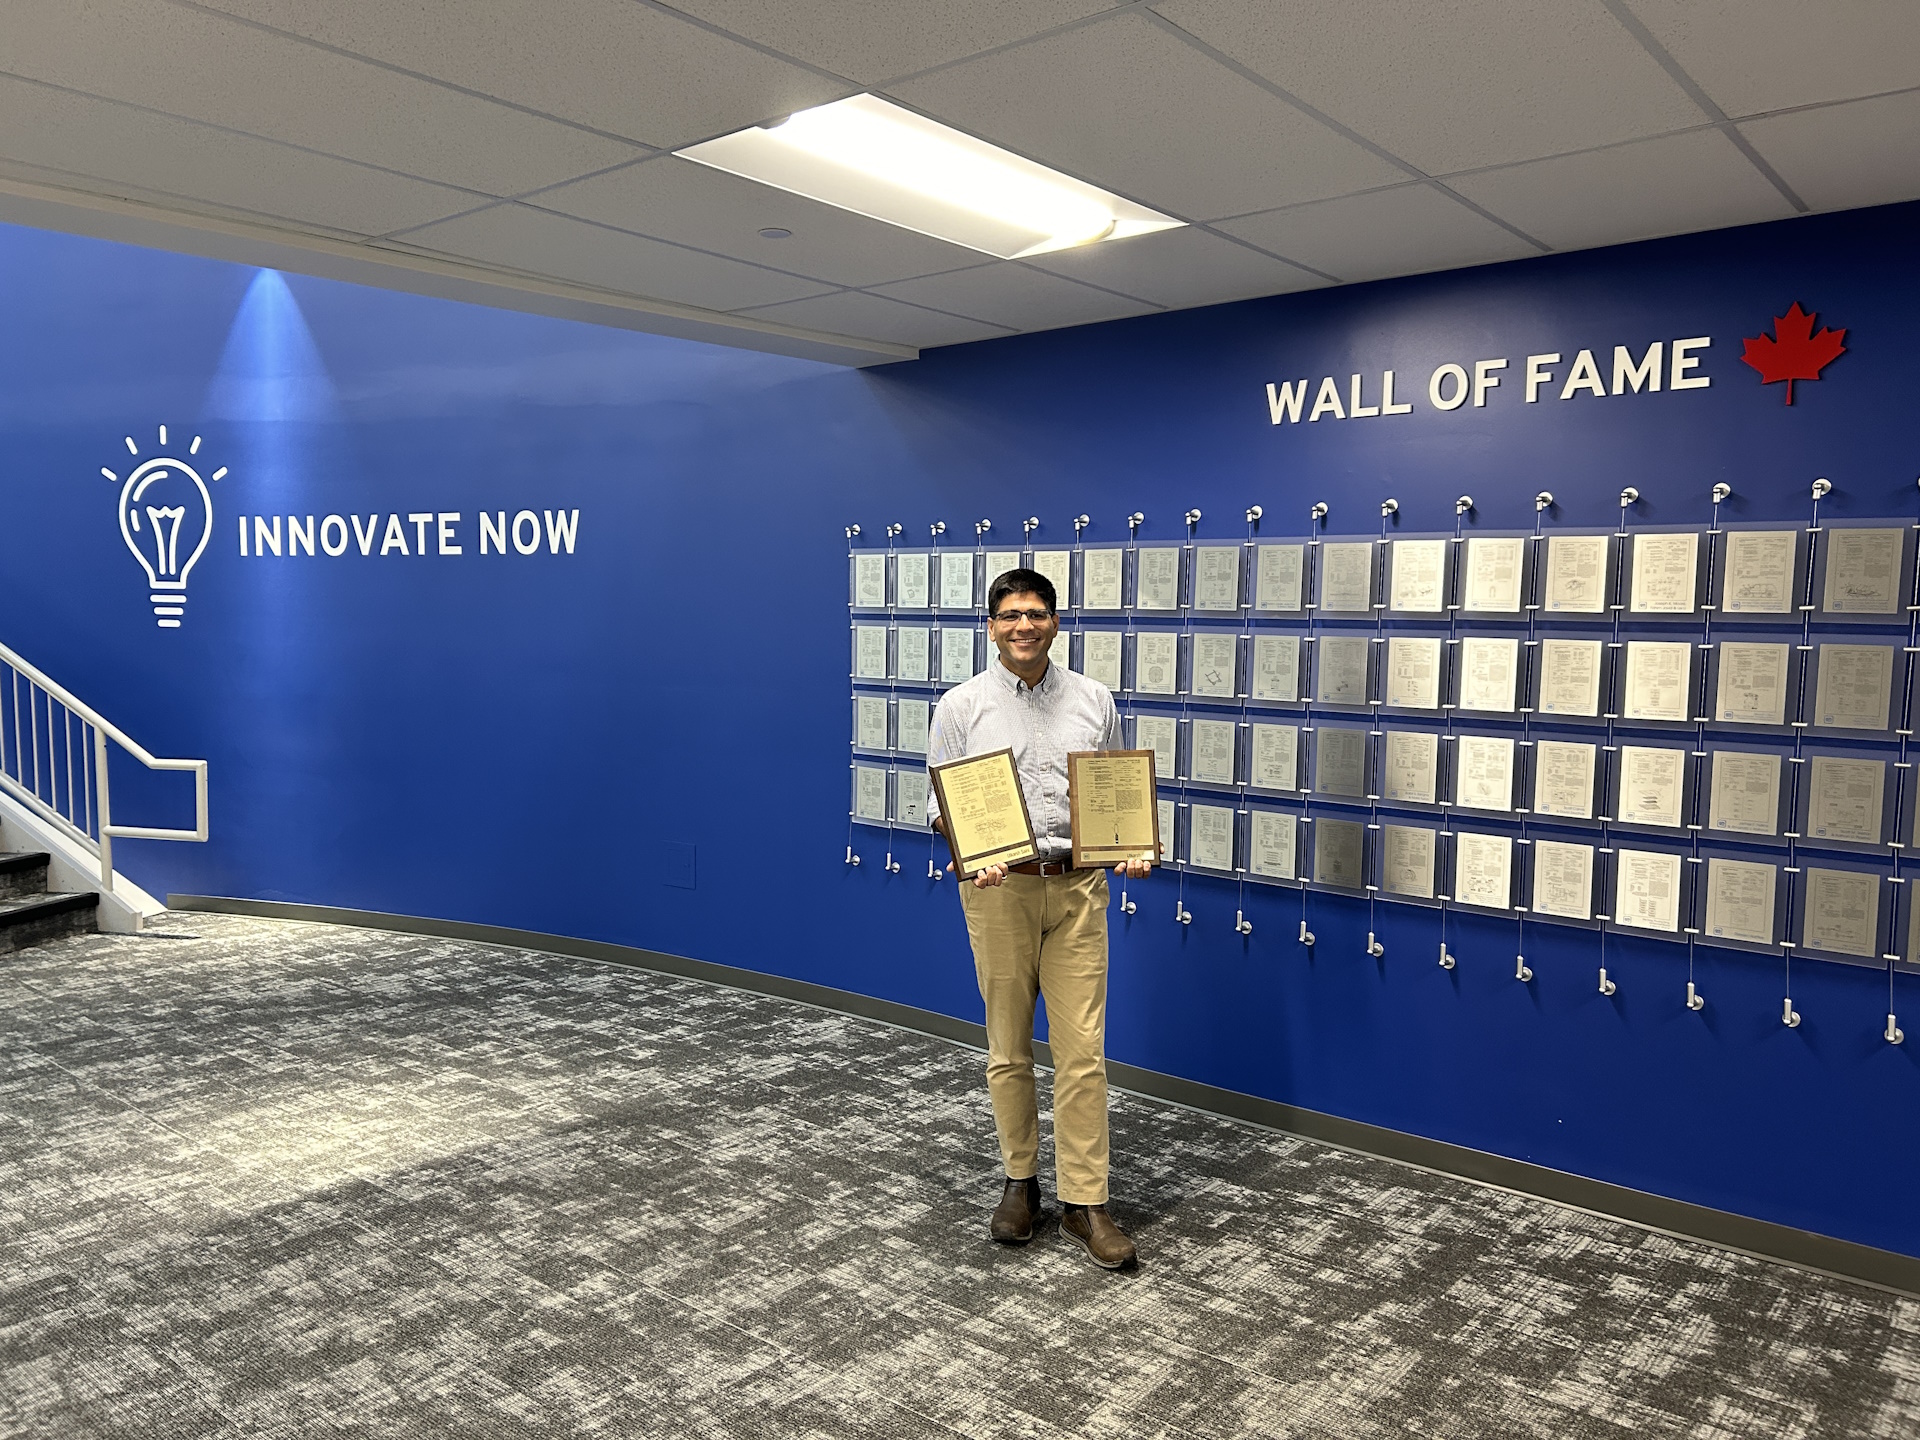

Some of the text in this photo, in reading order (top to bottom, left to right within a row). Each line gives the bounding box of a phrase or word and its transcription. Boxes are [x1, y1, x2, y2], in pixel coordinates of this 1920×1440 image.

[1266, 336, 1711, 425] WALL OF FAME
[239, 509, 580, 557] INNOVATE NOW
